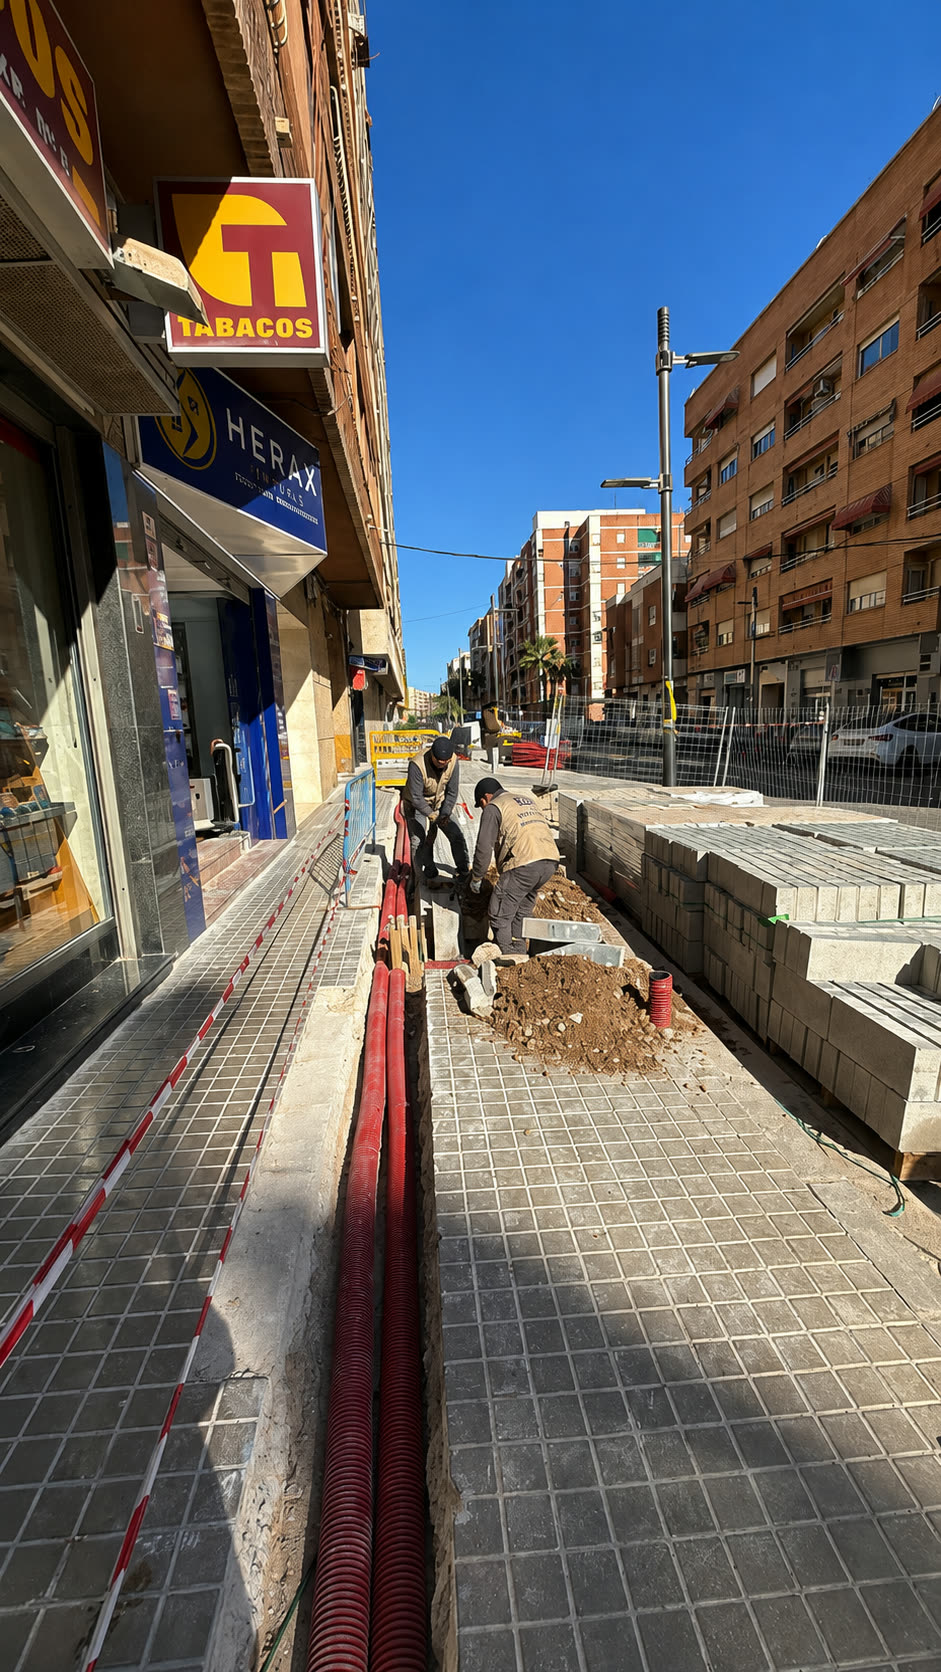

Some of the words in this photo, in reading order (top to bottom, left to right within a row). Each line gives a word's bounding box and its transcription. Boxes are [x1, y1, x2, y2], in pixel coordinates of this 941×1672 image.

[0, 0, 93, 166] OS
[177, 316, 313, 338] TABACOS
[226, 407, 317, 497] HERAX
